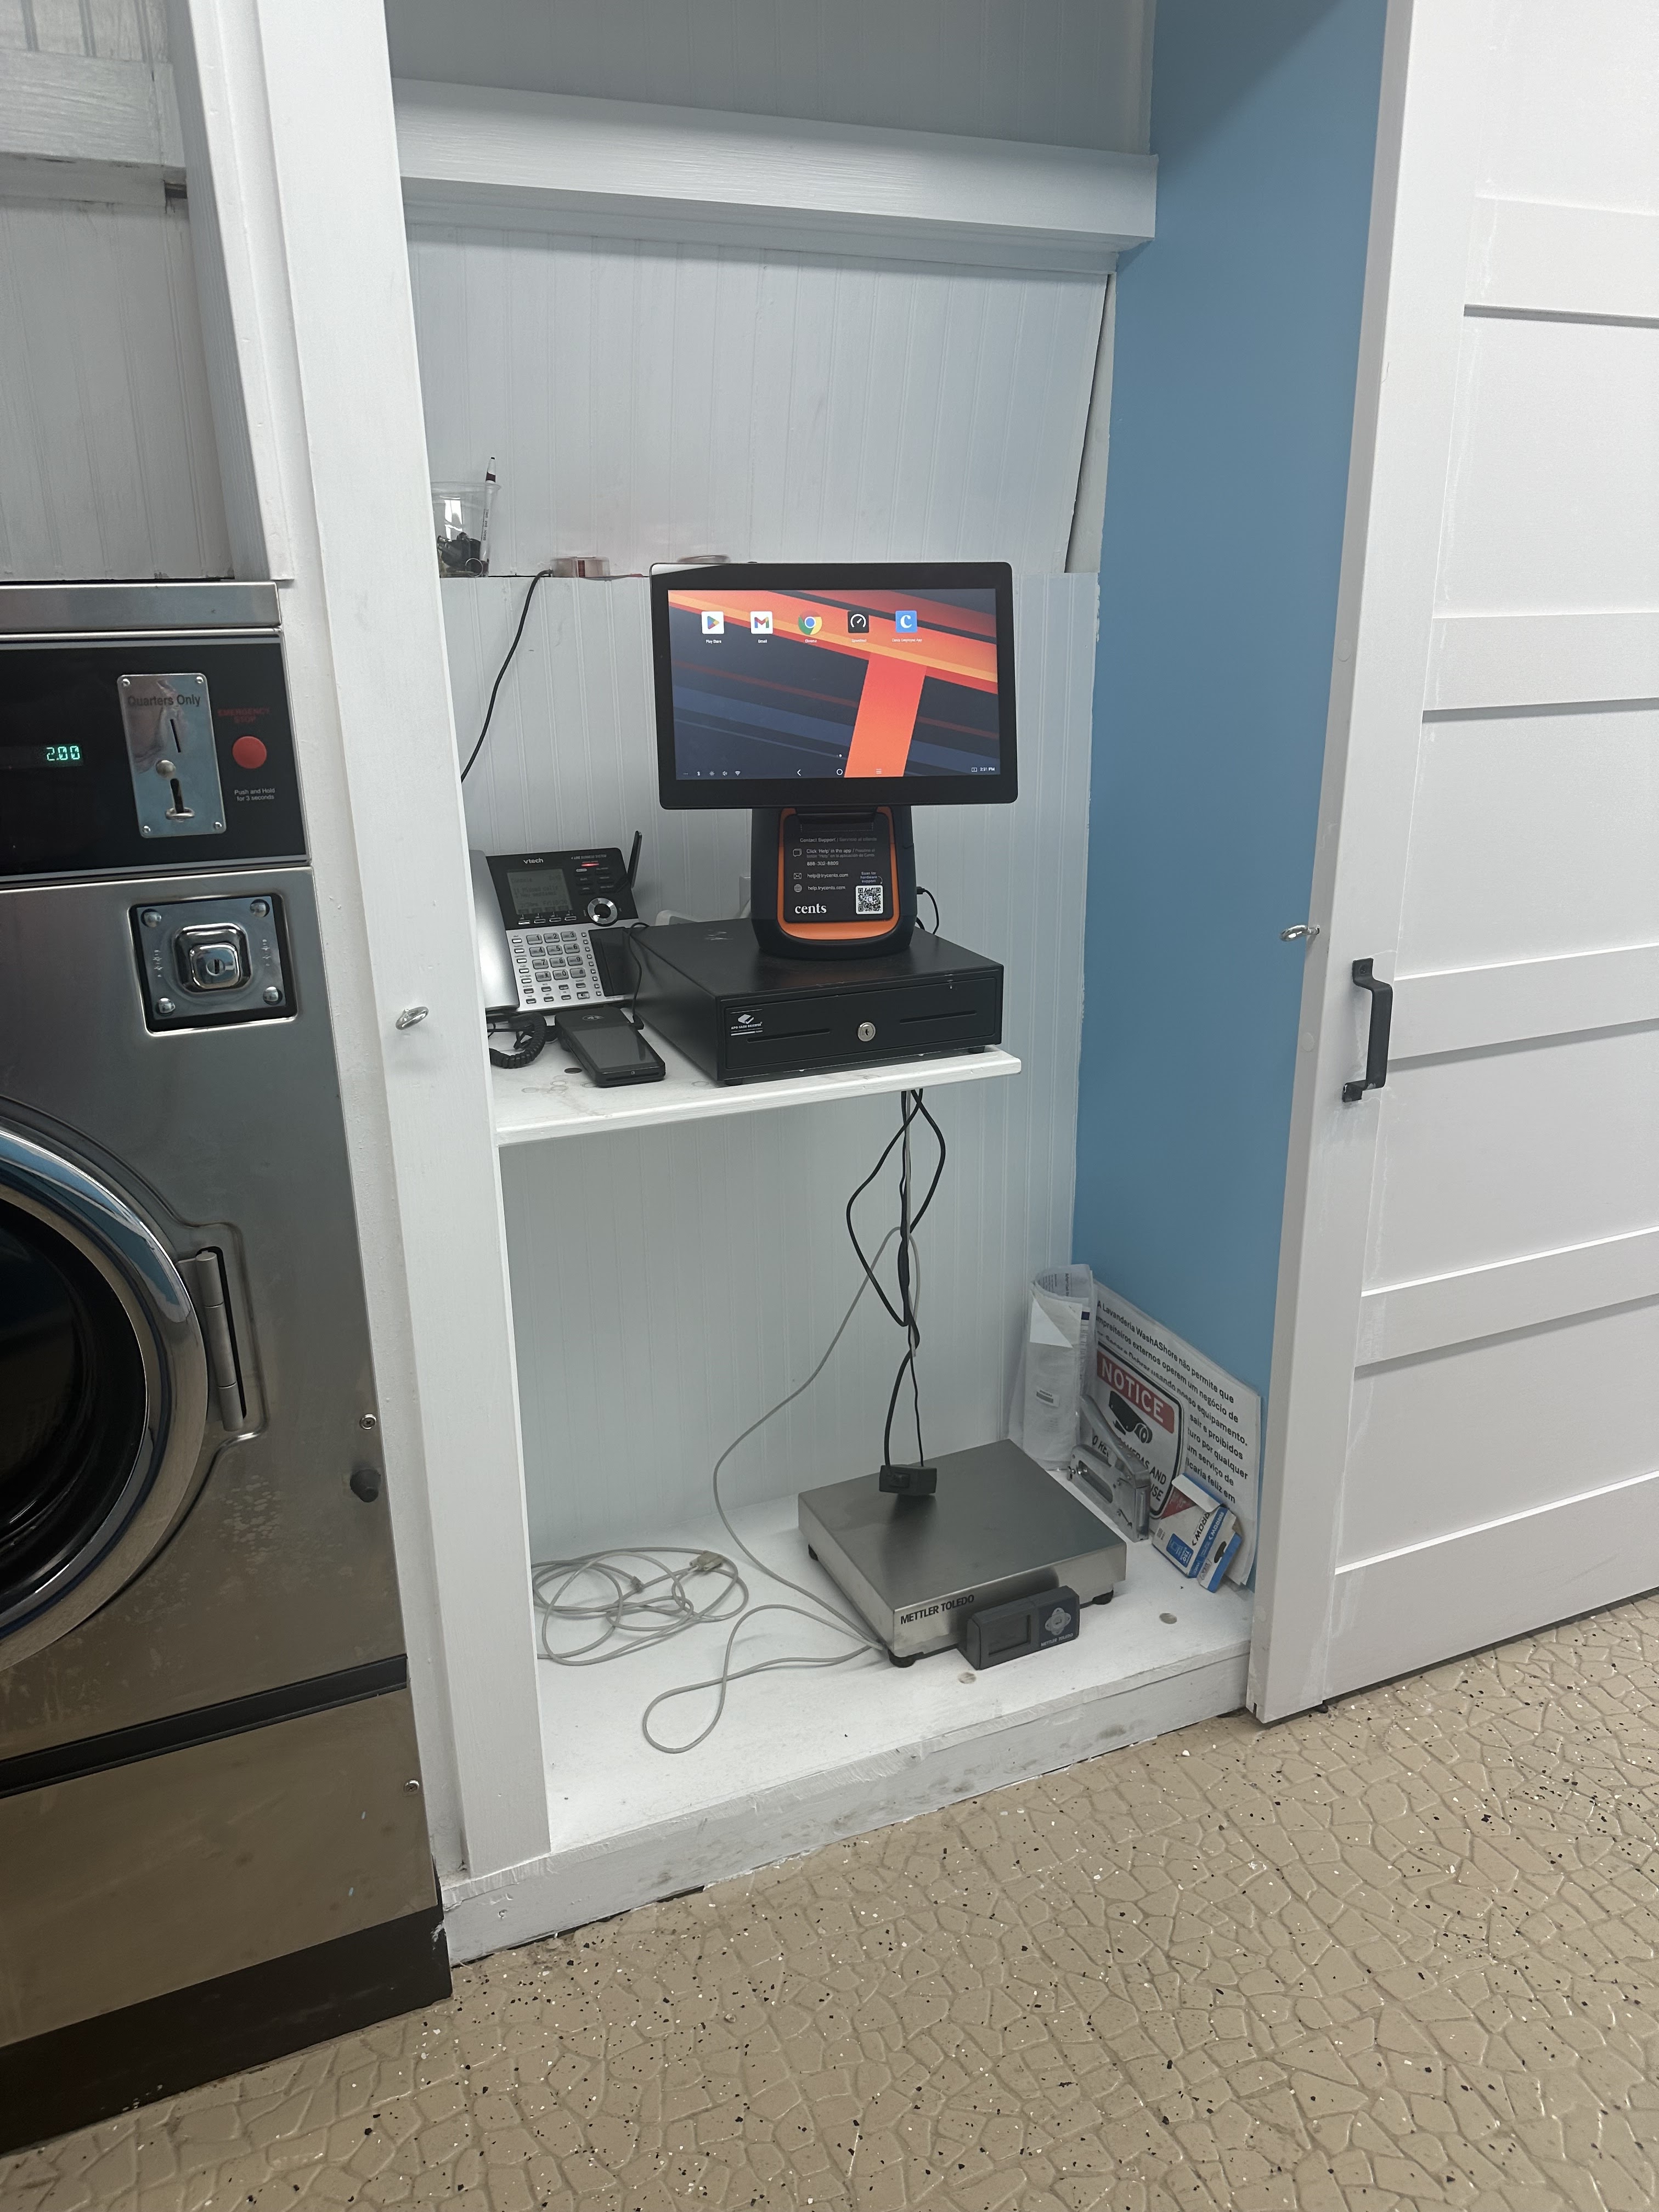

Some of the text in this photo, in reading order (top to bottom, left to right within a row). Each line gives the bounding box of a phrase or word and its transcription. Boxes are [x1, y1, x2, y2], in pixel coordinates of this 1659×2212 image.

[128, 695, 201, 707] Quarters Only
[46, 746, 80, 761] 2.00
[795, 904, 827, 913] cents
[1103, 1303, 1135, 1333] Lavanderia
[1136, 1326, 1178, 1362] WashAShore
[1179, 1358, 1190, 1372] não
[1192, 1368, 1218, 1392] permite
[1219, 1389, 1234, 1403] que
[1102, 1357, 1164, 1424] NOTICE
[1132, 1341, 1160, 1365] externos
[1162, 1362, 1187, 1384] operem
[1188, 1381, 1198, 1394] um
[1199, 1391, 1227, 1416] negócio
[1228, 1412, 1238, 1423] de
[1190, 1414, 1201, 1428] sair
[1209, 1429, 1243, 1460] proibidos
[1197, 1404, 1248, 1446] equipamento.
[1199, 1453, 1223, 1478] serviço
[1224, 1474, 1234, 1486] de
[1202, 1440, 1213, 1453] por
[1214, 1450, 1248, 1480] qualquer
[1149, 1466, 1166, 1485] AND
[1207, 1475, 1222, 1494] feliz
[1224, 1489, 1235, 1504] em
[1195, 1513, 1210, 1542] RROW
[1211, 1511, 1224, 1536] ARROW
[900, 1594, 975, 1624] METTLER TOLEDO
[1041, 1633, 1074, 1646] METTLER TOLEDO
